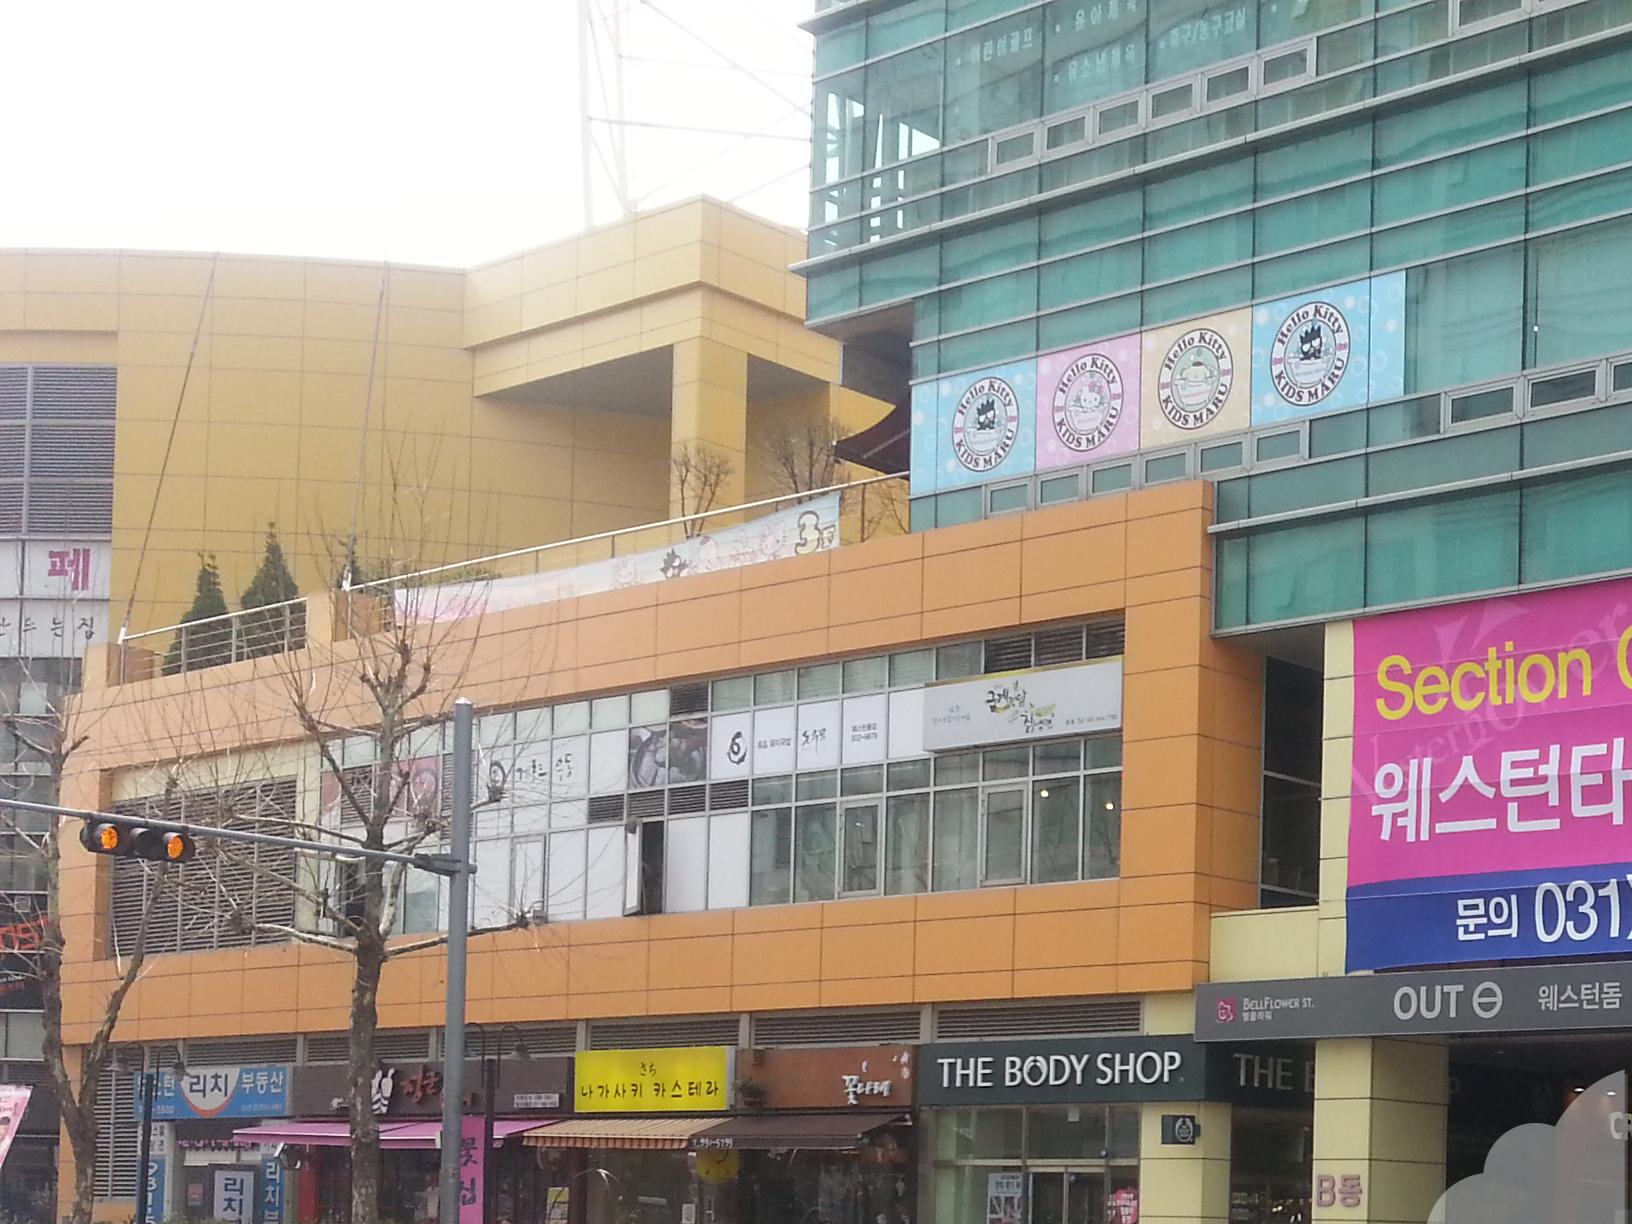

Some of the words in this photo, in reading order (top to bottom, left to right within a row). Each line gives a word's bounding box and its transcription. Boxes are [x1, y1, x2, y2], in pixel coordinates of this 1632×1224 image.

[1277, 310, 1309, 346] Hello
[1313, 305, 1343, 334] Kitty
[1165, 337, 1194, 371] Hello
[1198, 332, 1227, 361] Kitty
[1059, 360, 1087, 395] Hello
[1090, 356, 1117, 385] Kitty
[1274, 370, 1304, 402] KIDS
[1308, 357, 1345, 402] MARU
[958, 384, 985, 417] Hello
[988, 380, 1014, 408] Kitty
[1161, 394, 1190, 426] KIDS
[1193, 382, 1228, 427] MARU
[1057, 419, 1082, 448] KIDS
[1086, 406, 1119, 448] MARU
[955, 440, 980, 469] KIDS
[983, 428, 1014, 469] MARU
[1376, 640, 1592, 721] Section
[1456, 894, 1519, 942] 문의
[1392, 983, 1464, 1021] OUT
[1537, 981, 1623, 1012] 웨스턴돔
[189, 1073, 229, 1098] 리치
[241, 1071, 284, 1095] 부동산
[937, 1056, 995, 1088] THE
[1004, 1053, 1091, 1087] BODY
[1096, 1051, 1182, 1086] SHOP
[1233, 1052, 1295, 1091] THE
[581, 1082, 644, 1099] 나가사키
[653, 1080, 719, 1098] 카스테라
[1317, 1174, 1363, 1208] B동
